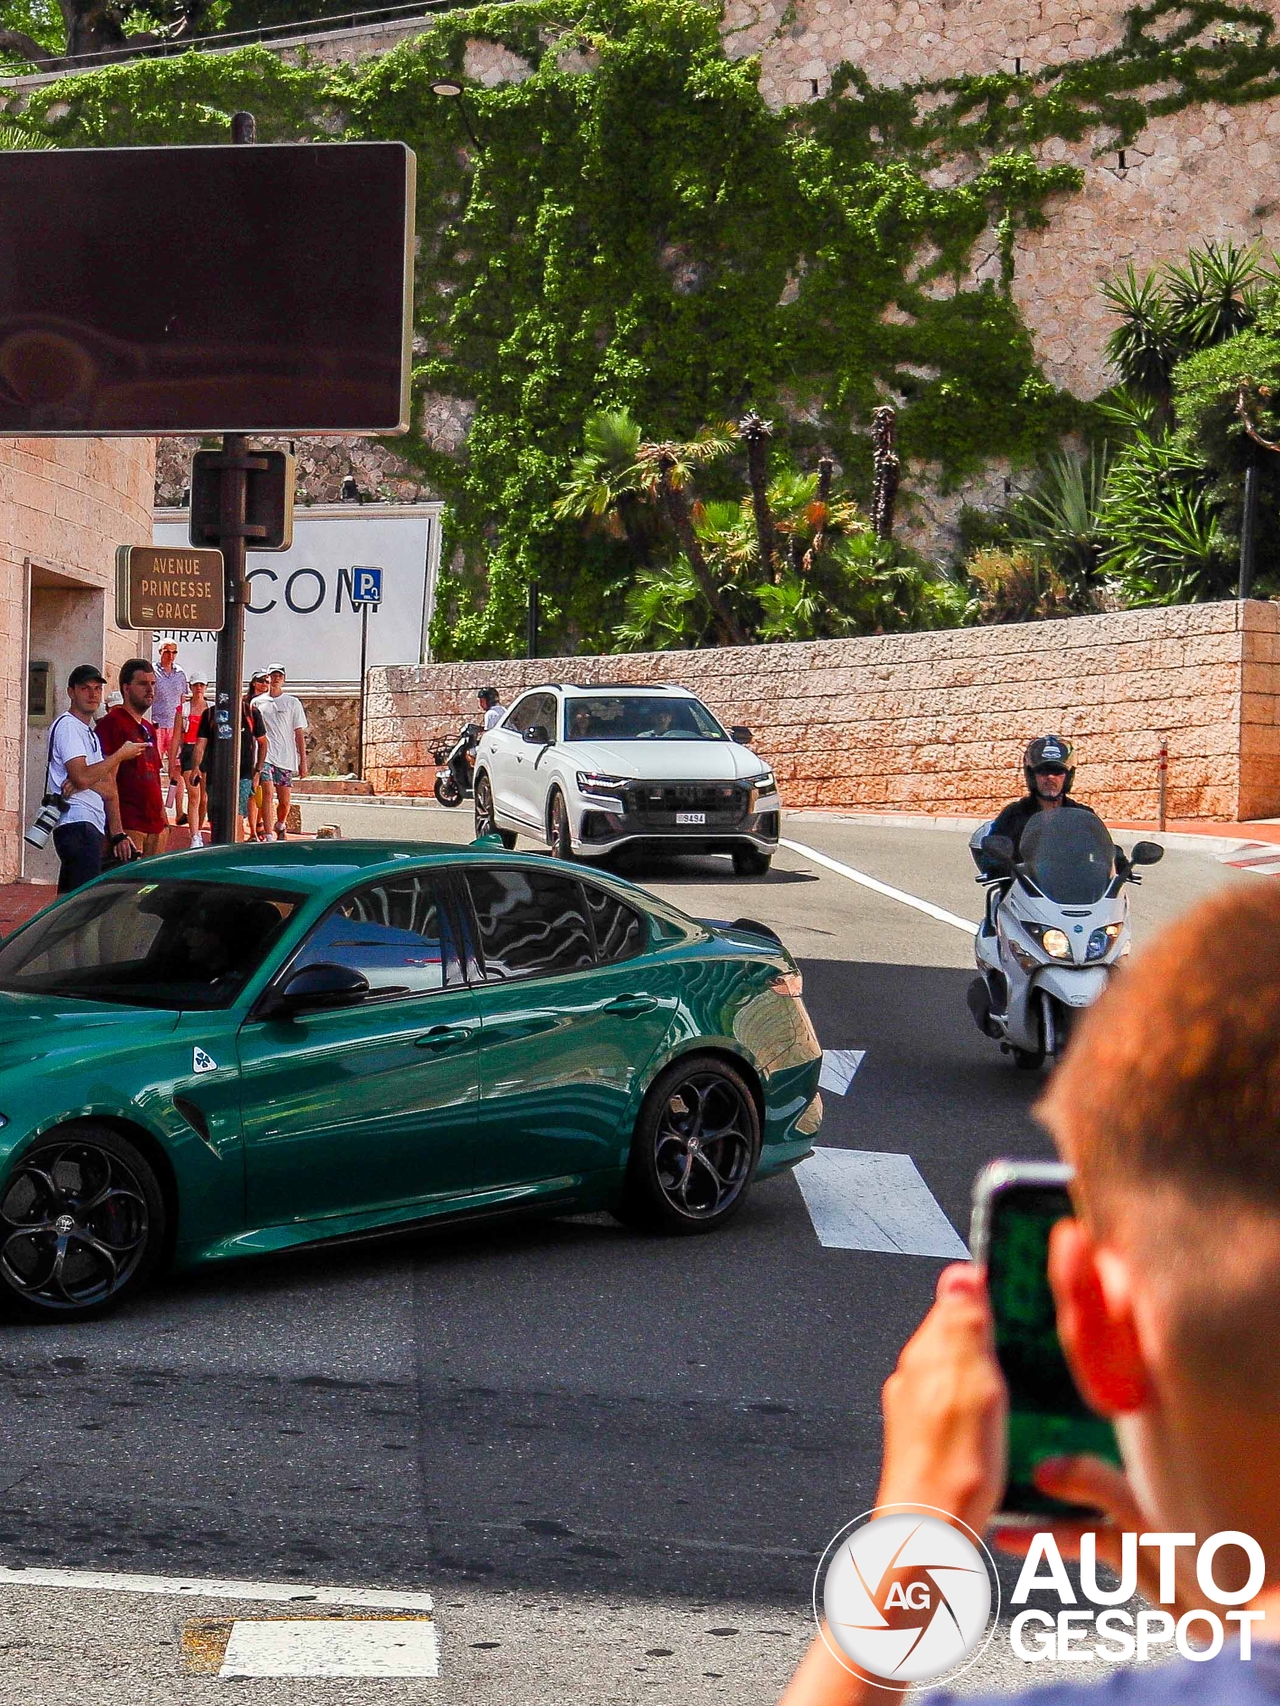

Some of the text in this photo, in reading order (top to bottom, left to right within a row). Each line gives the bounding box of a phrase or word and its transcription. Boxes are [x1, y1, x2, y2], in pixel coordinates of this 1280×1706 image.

[152, 557, 200, 575] AVENUE
[141, 579, 212, 598] PRINCESSE
[156, 602, 198, 620] GRACE
[152, 630, 245, 643] SURAN
